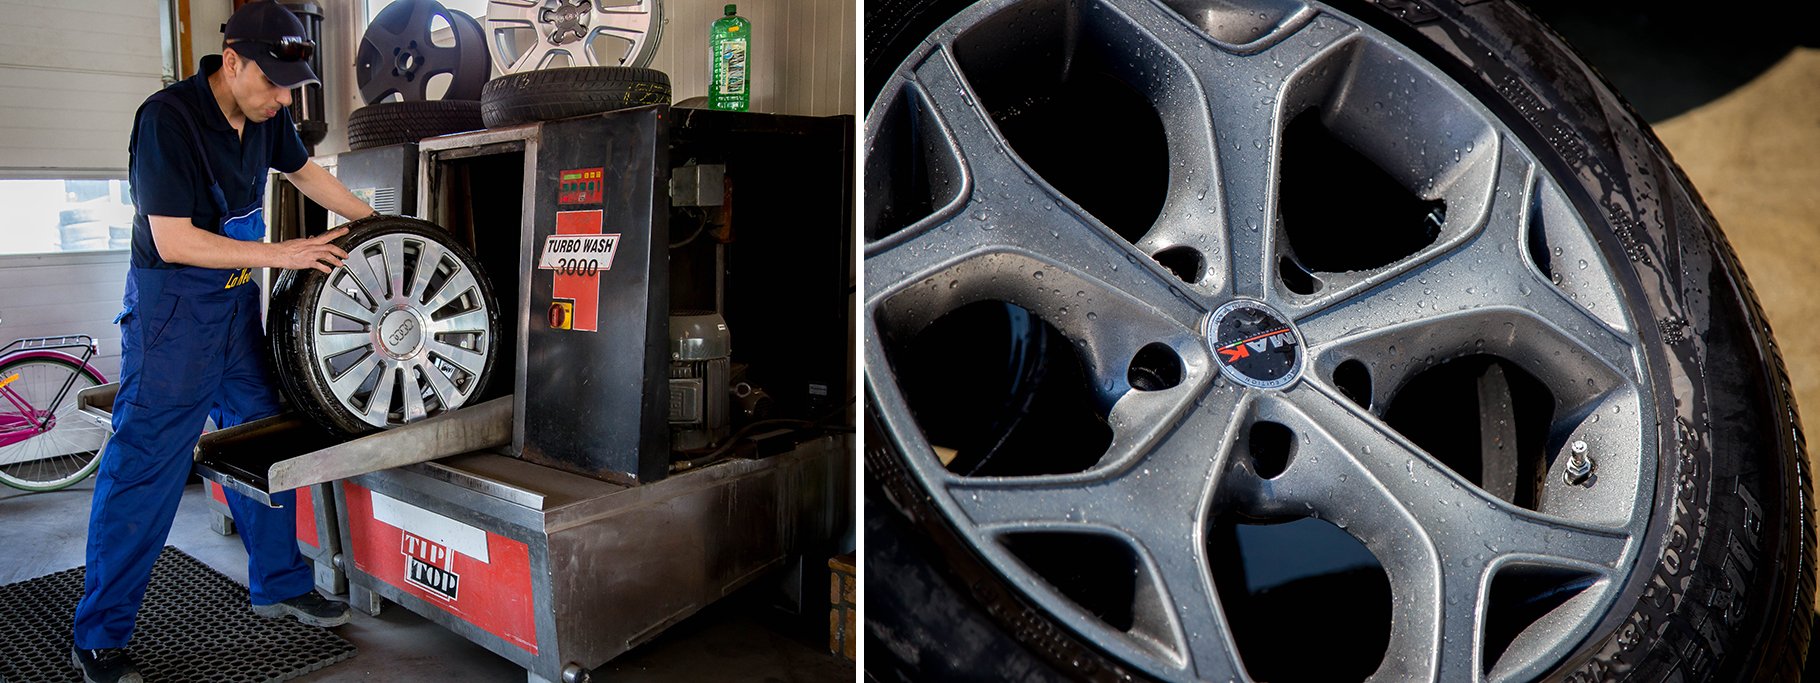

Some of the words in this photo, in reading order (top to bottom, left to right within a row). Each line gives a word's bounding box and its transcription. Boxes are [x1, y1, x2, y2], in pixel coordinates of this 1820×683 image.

[548, 239, 581, 254] TURBO
[583, 238, 614, 254] WASH
[557, 258, 599, 277] 3000
[1218, 331, 1297, 363] MAK
[404, 534, 446, 563] TIP
[412, 562, 456, 592] TOP
